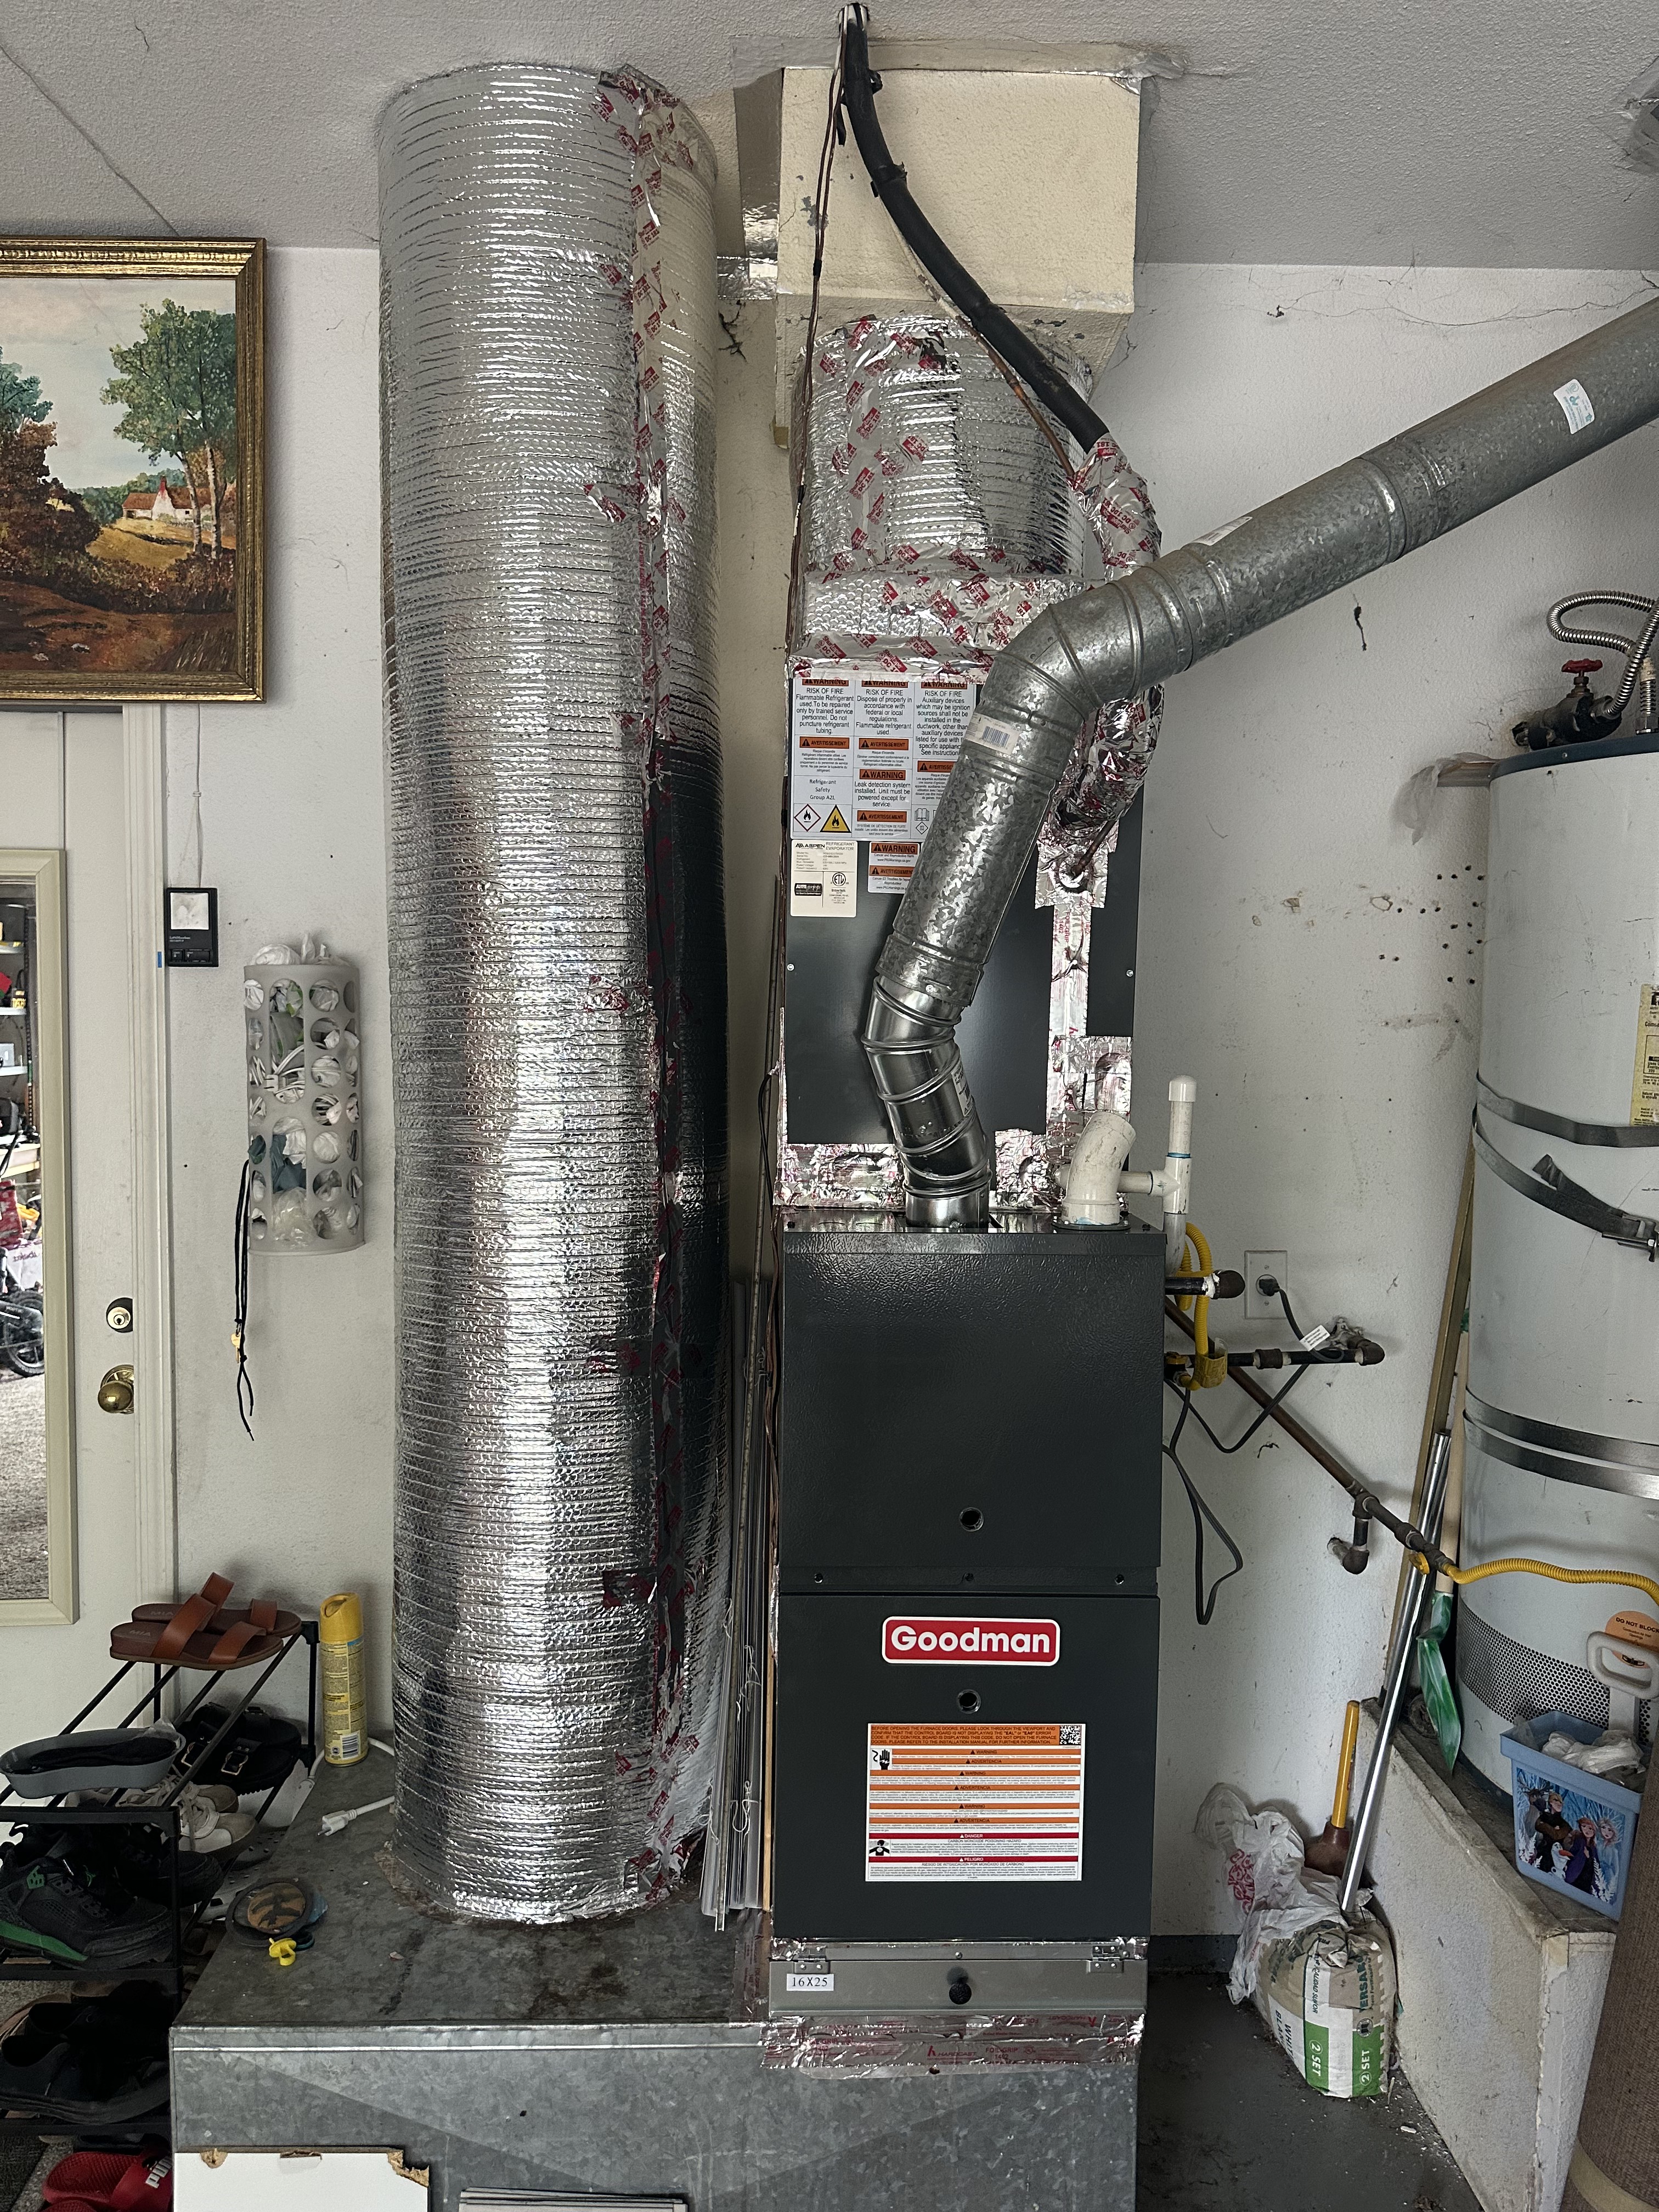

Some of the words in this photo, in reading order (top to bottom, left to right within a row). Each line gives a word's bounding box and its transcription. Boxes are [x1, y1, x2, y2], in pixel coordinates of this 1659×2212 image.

[858, 483, 866, 492] DC
[865, 472, 875, 483] 181
[882, 845, 915, 853] WARNING
[891, 1626, 1050, 1653] Goodman
[792, 1977, 827, 1987] 16X25
[1311, 2054, 1321, 2076] SET
[1362, 2050, 1370, 2070] SET
